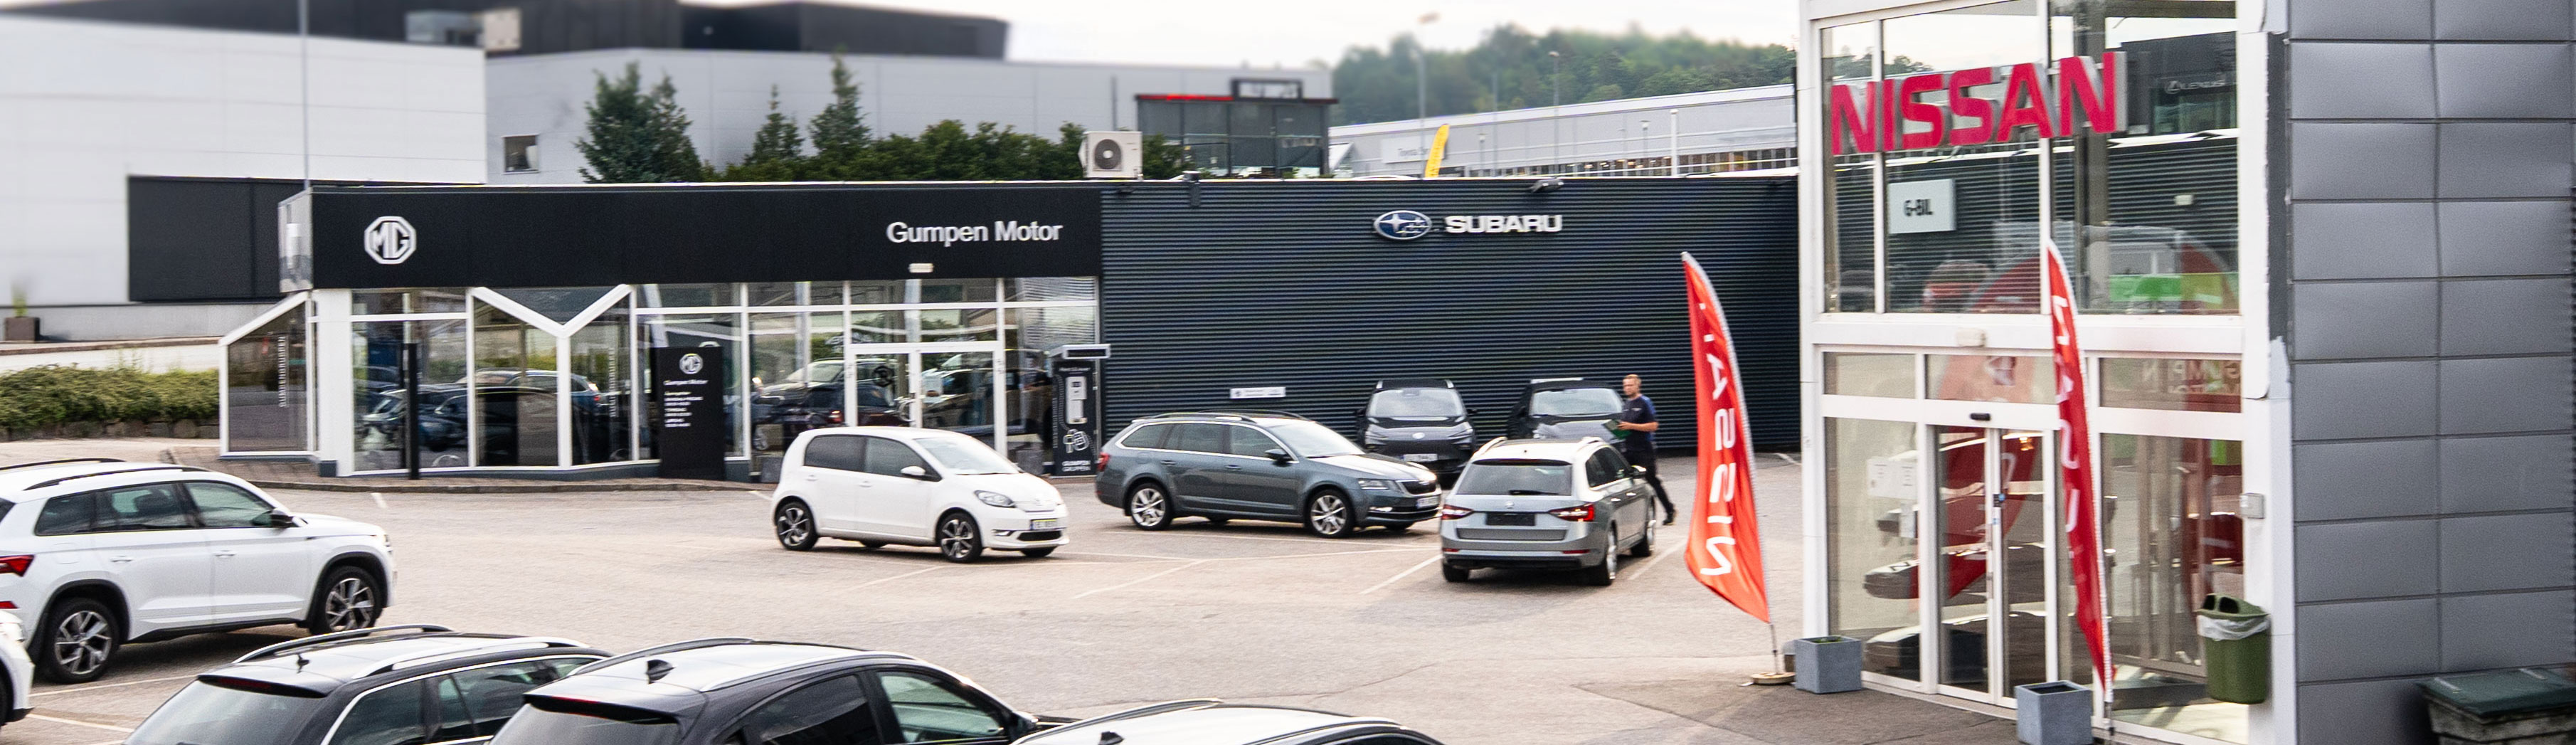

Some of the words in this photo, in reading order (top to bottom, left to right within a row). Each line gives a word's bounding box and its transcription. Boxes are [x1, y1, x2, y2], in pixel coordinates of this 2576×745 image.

[1831, 51, 2120, 155] NISSAN
[366, 218, 414, 262] MG
[886, 221, 988, 247] Gumpen
[995, 221, 1064, 241] Motor
[1445, 215, 1562, 233] SUBARU
